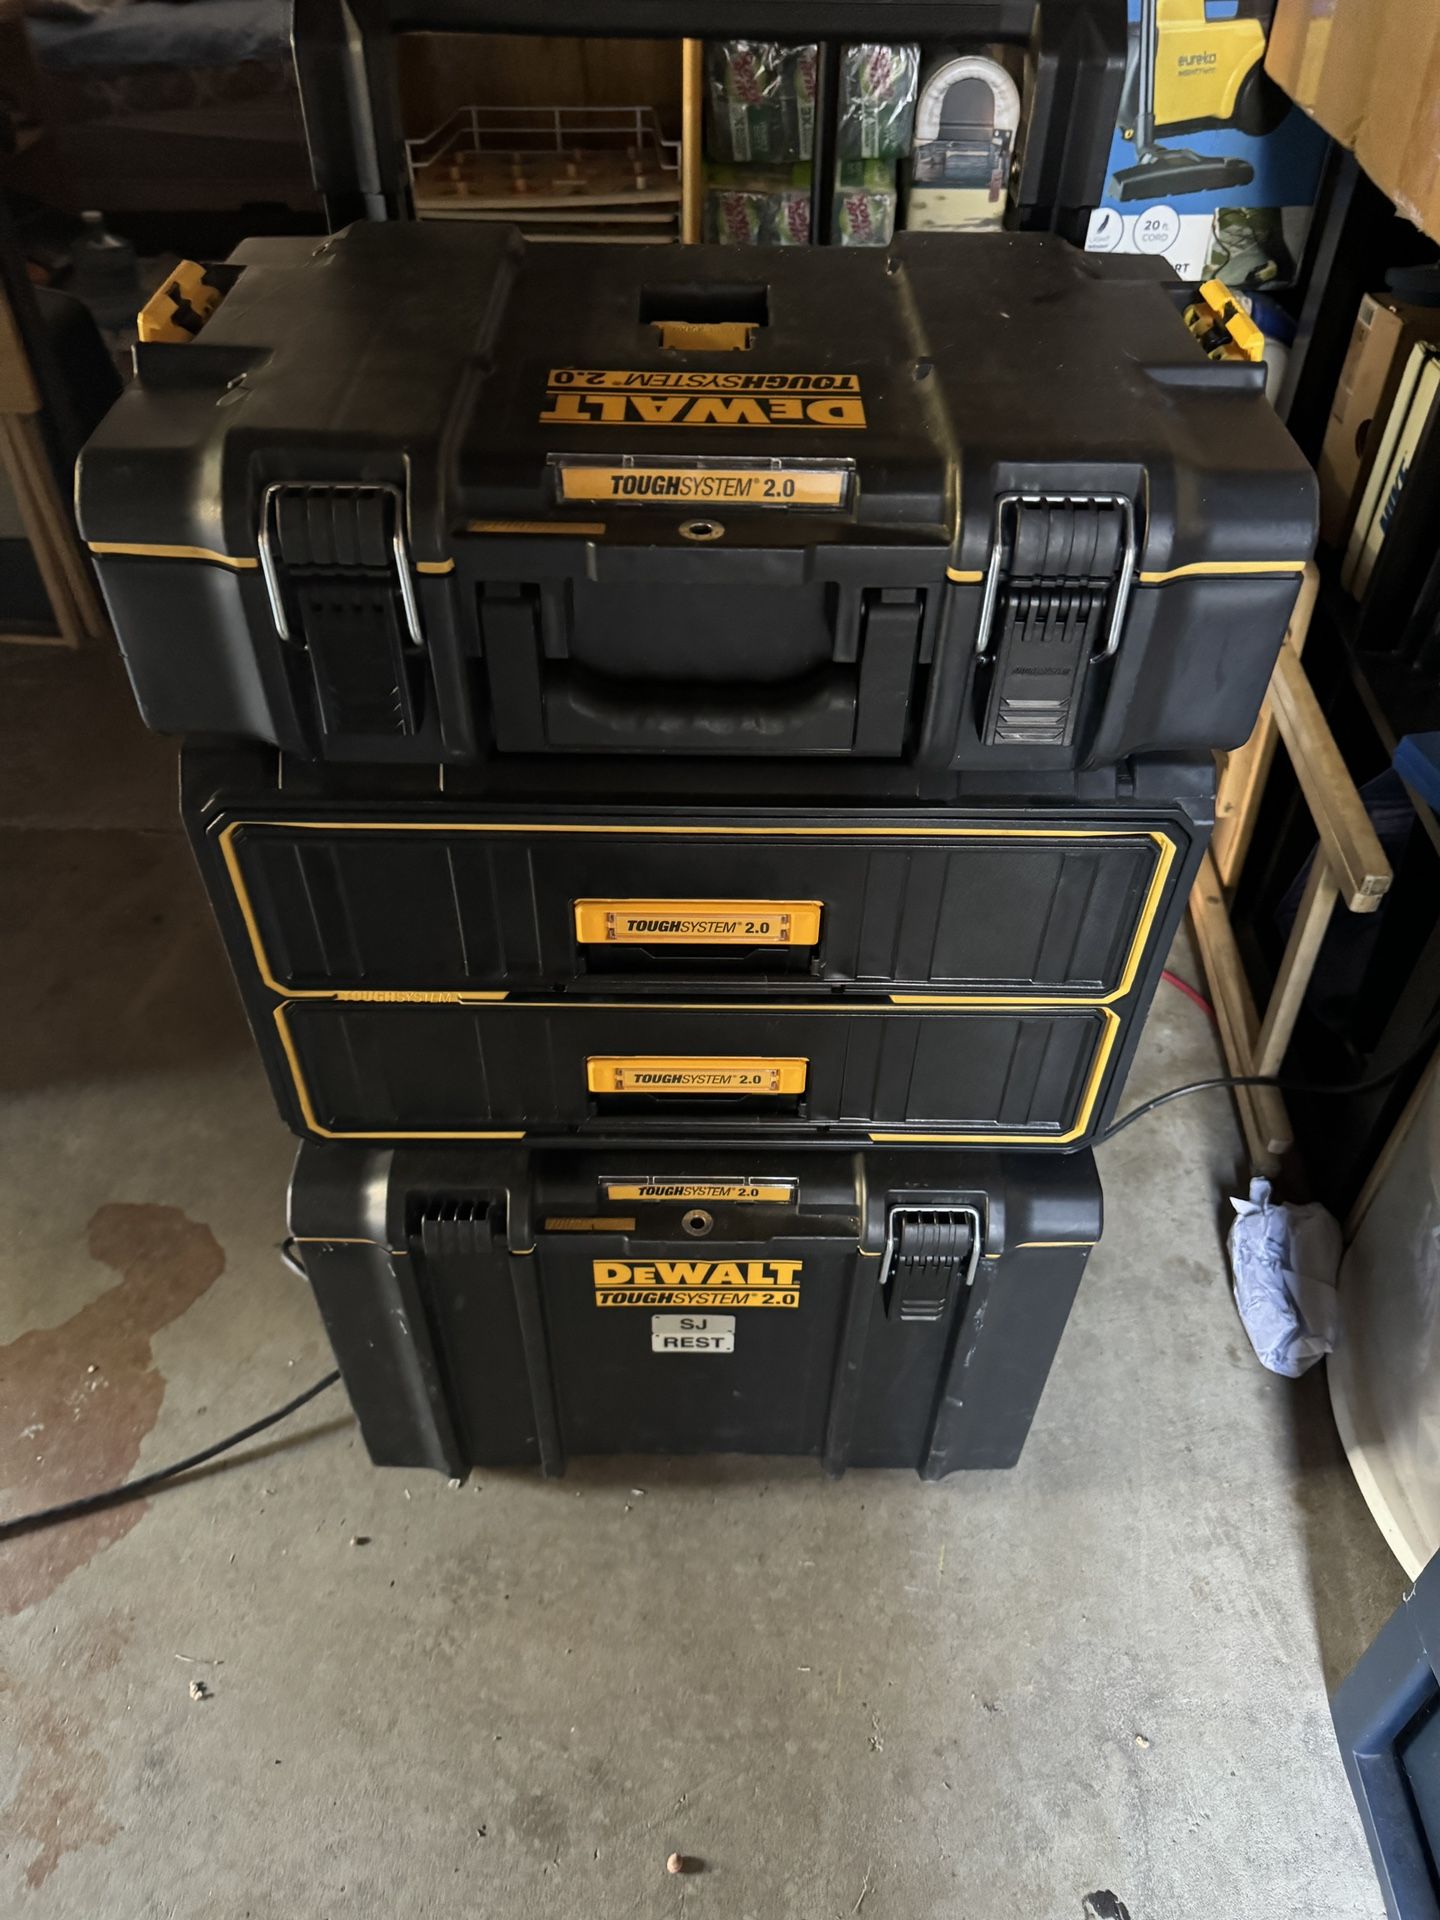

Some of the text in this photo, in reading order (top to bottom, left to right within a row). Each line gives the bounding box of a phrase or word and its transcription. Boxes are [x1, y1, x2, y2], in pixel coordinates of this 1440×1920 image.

[1143, 219, 1161, 231] 20
[553, 370, 606, 386] 2.0
[762, 478, 795, 498] 2.0
[744, 921, 770, 934] 2.0
[739, 1075, 762, 1085] 2.0
[738, 1187, 759, 1197] 2.0
[761, 1293, 796, 1305] 2.0
[679, 1318, 708, 1331] SJ
[663, 1337, 725, 1349] REST
